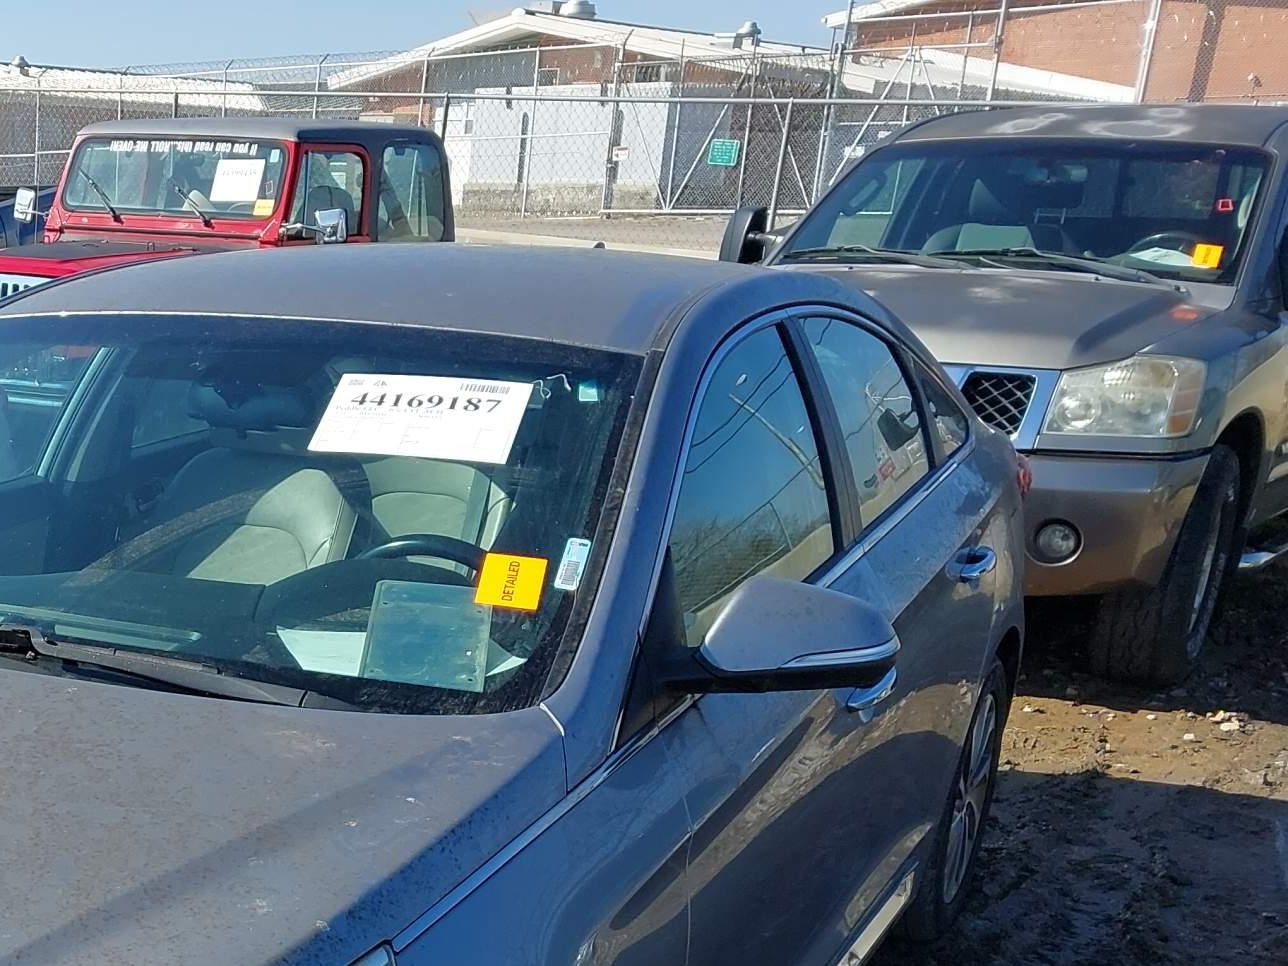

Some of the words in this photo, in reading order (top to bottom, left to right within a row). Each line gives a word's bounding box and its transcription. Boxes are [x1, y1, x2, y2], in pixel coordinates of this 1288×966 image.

[194, 141, 215, 153] read
[215, 142, 232, 153] can
[233, 142, 248, 154] you
[350, 392, 502, 413] 44169187
[501, 560, 520, 602] DETAILED
